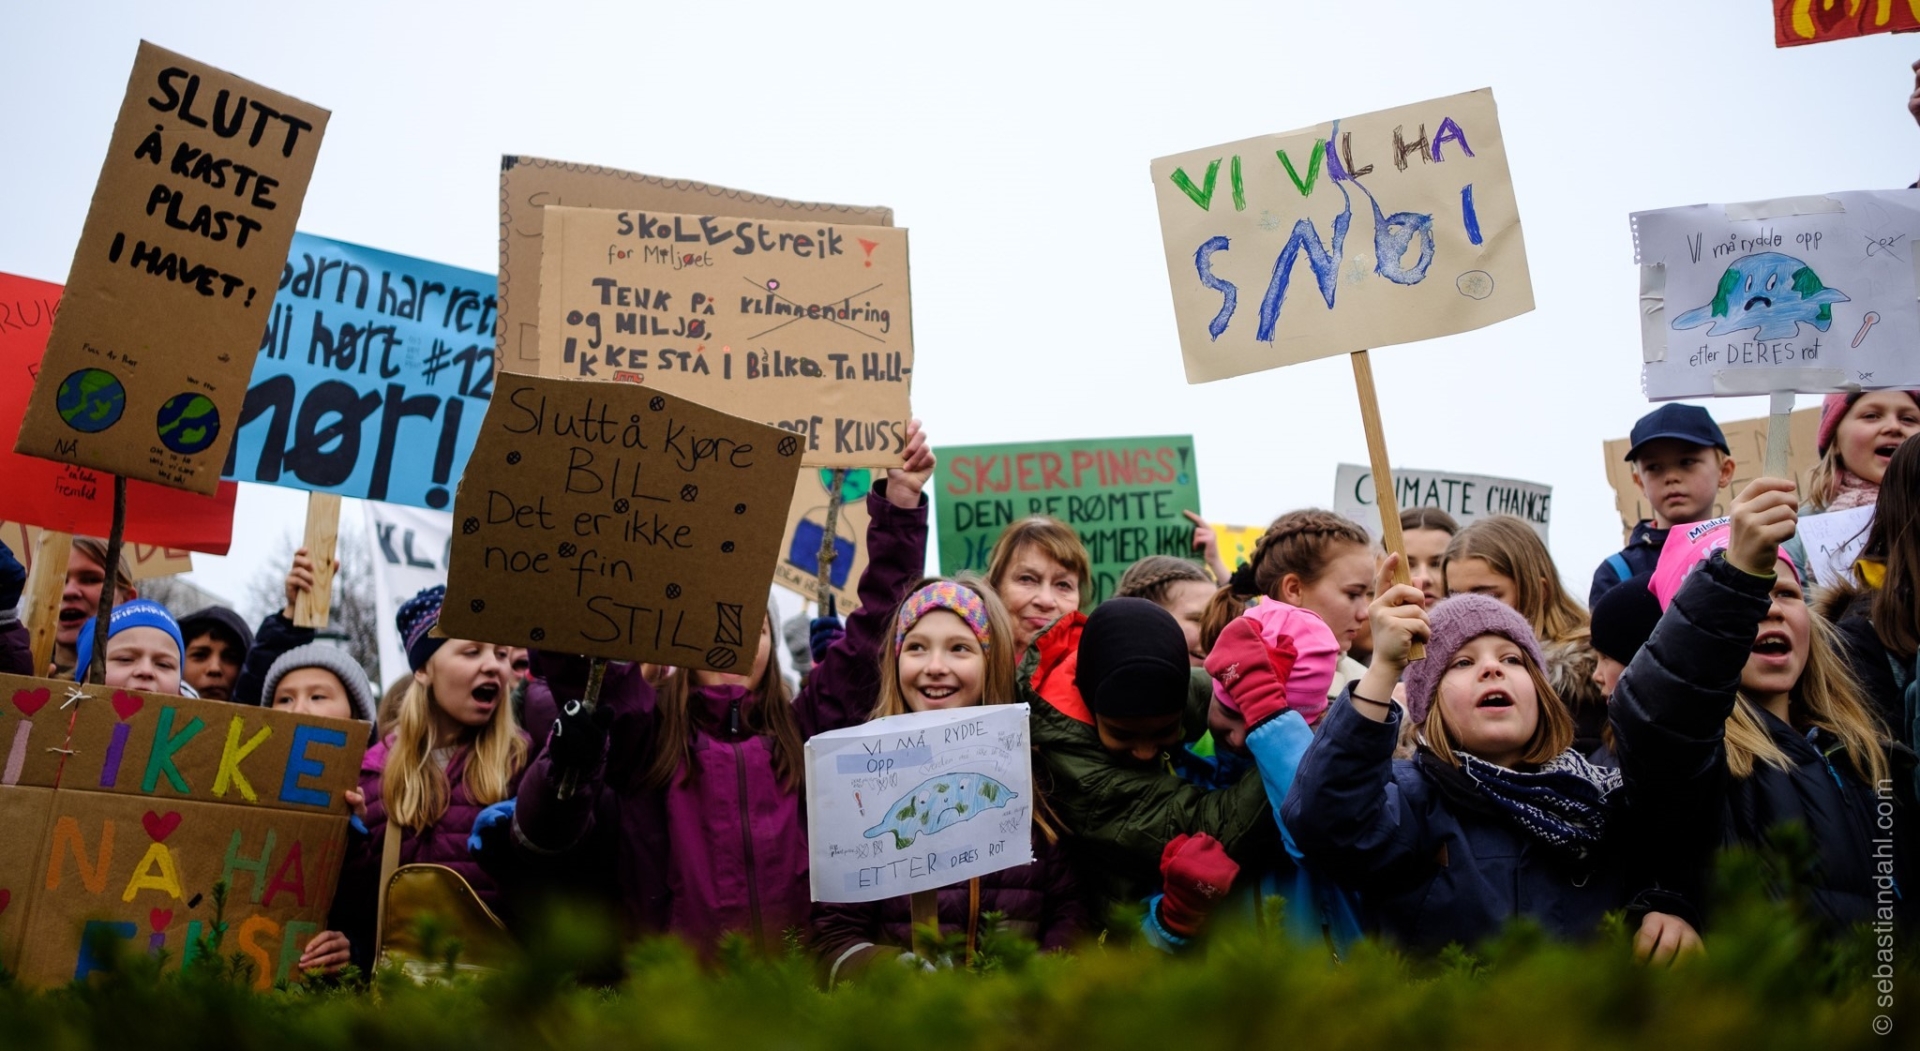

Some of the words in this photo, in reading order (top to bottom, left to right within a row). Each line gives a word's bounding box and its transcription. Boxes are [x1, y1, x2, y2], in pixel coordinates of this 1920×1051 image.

[148, 67, 312, 158] SLUTT
[134, 124, 164, 164] Å
[171, 142, 279, 210] KASTE
[1170, 155, 1247, 212] VI
[1393, 117, 1474, 172] HA
[146, 184, 262, 249] PLAST
[608, 244, 634, 271] for
[1713, 233, 1735, 258] må
[1796, 231, 1822, 249] opp
[109, 233, 125, 263] I
[130, 240, 257, 308] HAVET!
[592, 277, 672, 312] TENK
[377, 271, 446, 322] har
[307, 310, 403, 379] hørt
[566, 310, 602, 349] og
[1727, 342, 1795, 364] DERES
[1802, 337, 1822, 360] rot
[564, 337, 648, 377] IKKE
[503, 387, 618, 446] Slutt
[54, 438, 78, 458] NÅ
[565, 447, 671, 502] BIL
[1355, 474, 1476, 515] CIMATE
[1486, 485, 1550, 524] CHANGE
[488, 490, 556, 530] Det
[574, 510, 611, 536] er
[624, 509, 693, 549] ikke
[955, 500, 1012, 532] DEN
[1156, 525, 1200, 556] IKK
[485, 546, 549, 573] noe
[569, 549, 633, 596] fin
[863, 740, 881, 756] VI
[896, 730, 926, 750] MÅ
[944, 721, 988, 745] RYDDE
[859, 853, 937, 888] ETTER
[951, 849, 979, 867] DERES
[989, 840, 1005, 855] ROT
